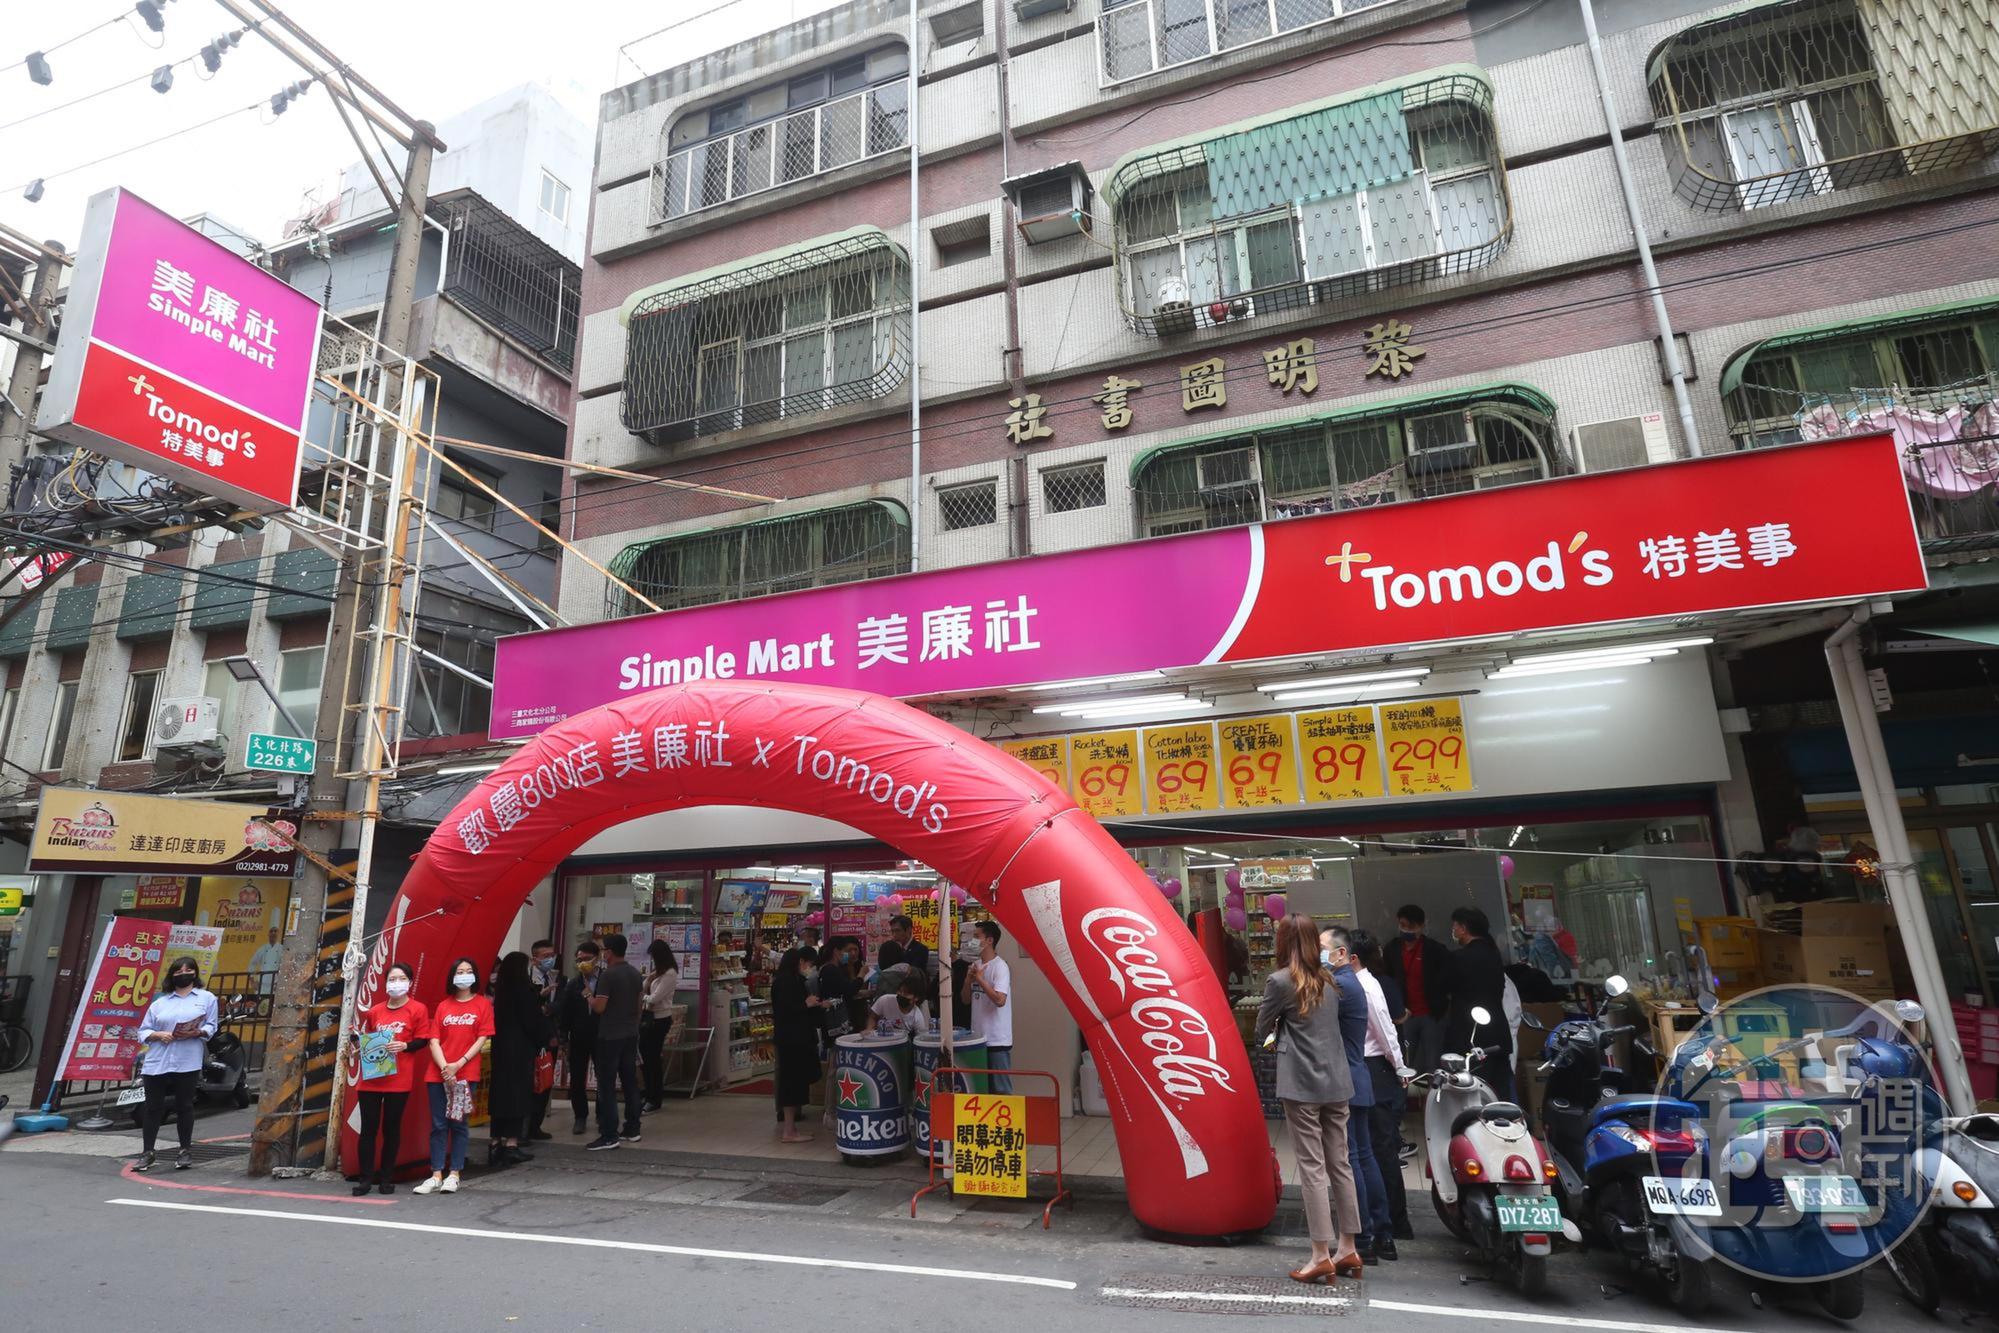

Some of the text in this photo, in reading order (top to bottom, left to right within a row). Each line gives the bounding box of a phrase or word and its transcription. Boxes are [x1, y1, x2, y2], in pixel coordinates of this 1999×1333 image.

[151, 258, 279, 353] 美廉社
[147, 293, 276, 369] Simple Mart
[146, 393, 257, 459] Tomod's
[160, 429, 225, 468] 特美事
[1639, 521, 1798, 581] 特美事
[1360, 531, 1614, 612] Tomod's
[619, 595, 1041, 690] Simple Mart 美廉社
[1222, 723, 1272, 740] CREATE
[1338, 712, 1358, 722] Life
[252, 737, 304, 754] 文化北路
[1074, 738, 1107, 750] Rocket
[1148, 731, 1207, 749] Cotton labo
[1390, 736, 1462, 771] 299
[254, 753, 297, 768] 226巷
[1229, 752, 1282, 786] 69
[1312, 744, 1366, 783] 89
[611, 720, 732, 779] 美廉社
[793, 734, 949, 835] Tomod's
[1080, 764, 1130, 797] 69
[1157, 760, 1208, 793] 69
[47, 836, 85, 847] Indian
[129, 835, 226, 855] 達達印度廚房
[235, 861, 289, 872] (02)2981-4779
[214, 918, 241, 928] Indian
[442, 1013, 477, 1026] Coca-Cola
[1081, 907, 1236, 1101] Coca-Cola
[964, 1096, 1011, 1127] 4/8
[957, 1124, 1024, 1151] 開幕活動
[955, 1149, 1021, 1180] 請勿停車
[1498, 1207, 1559, 1225] DYZ-287
